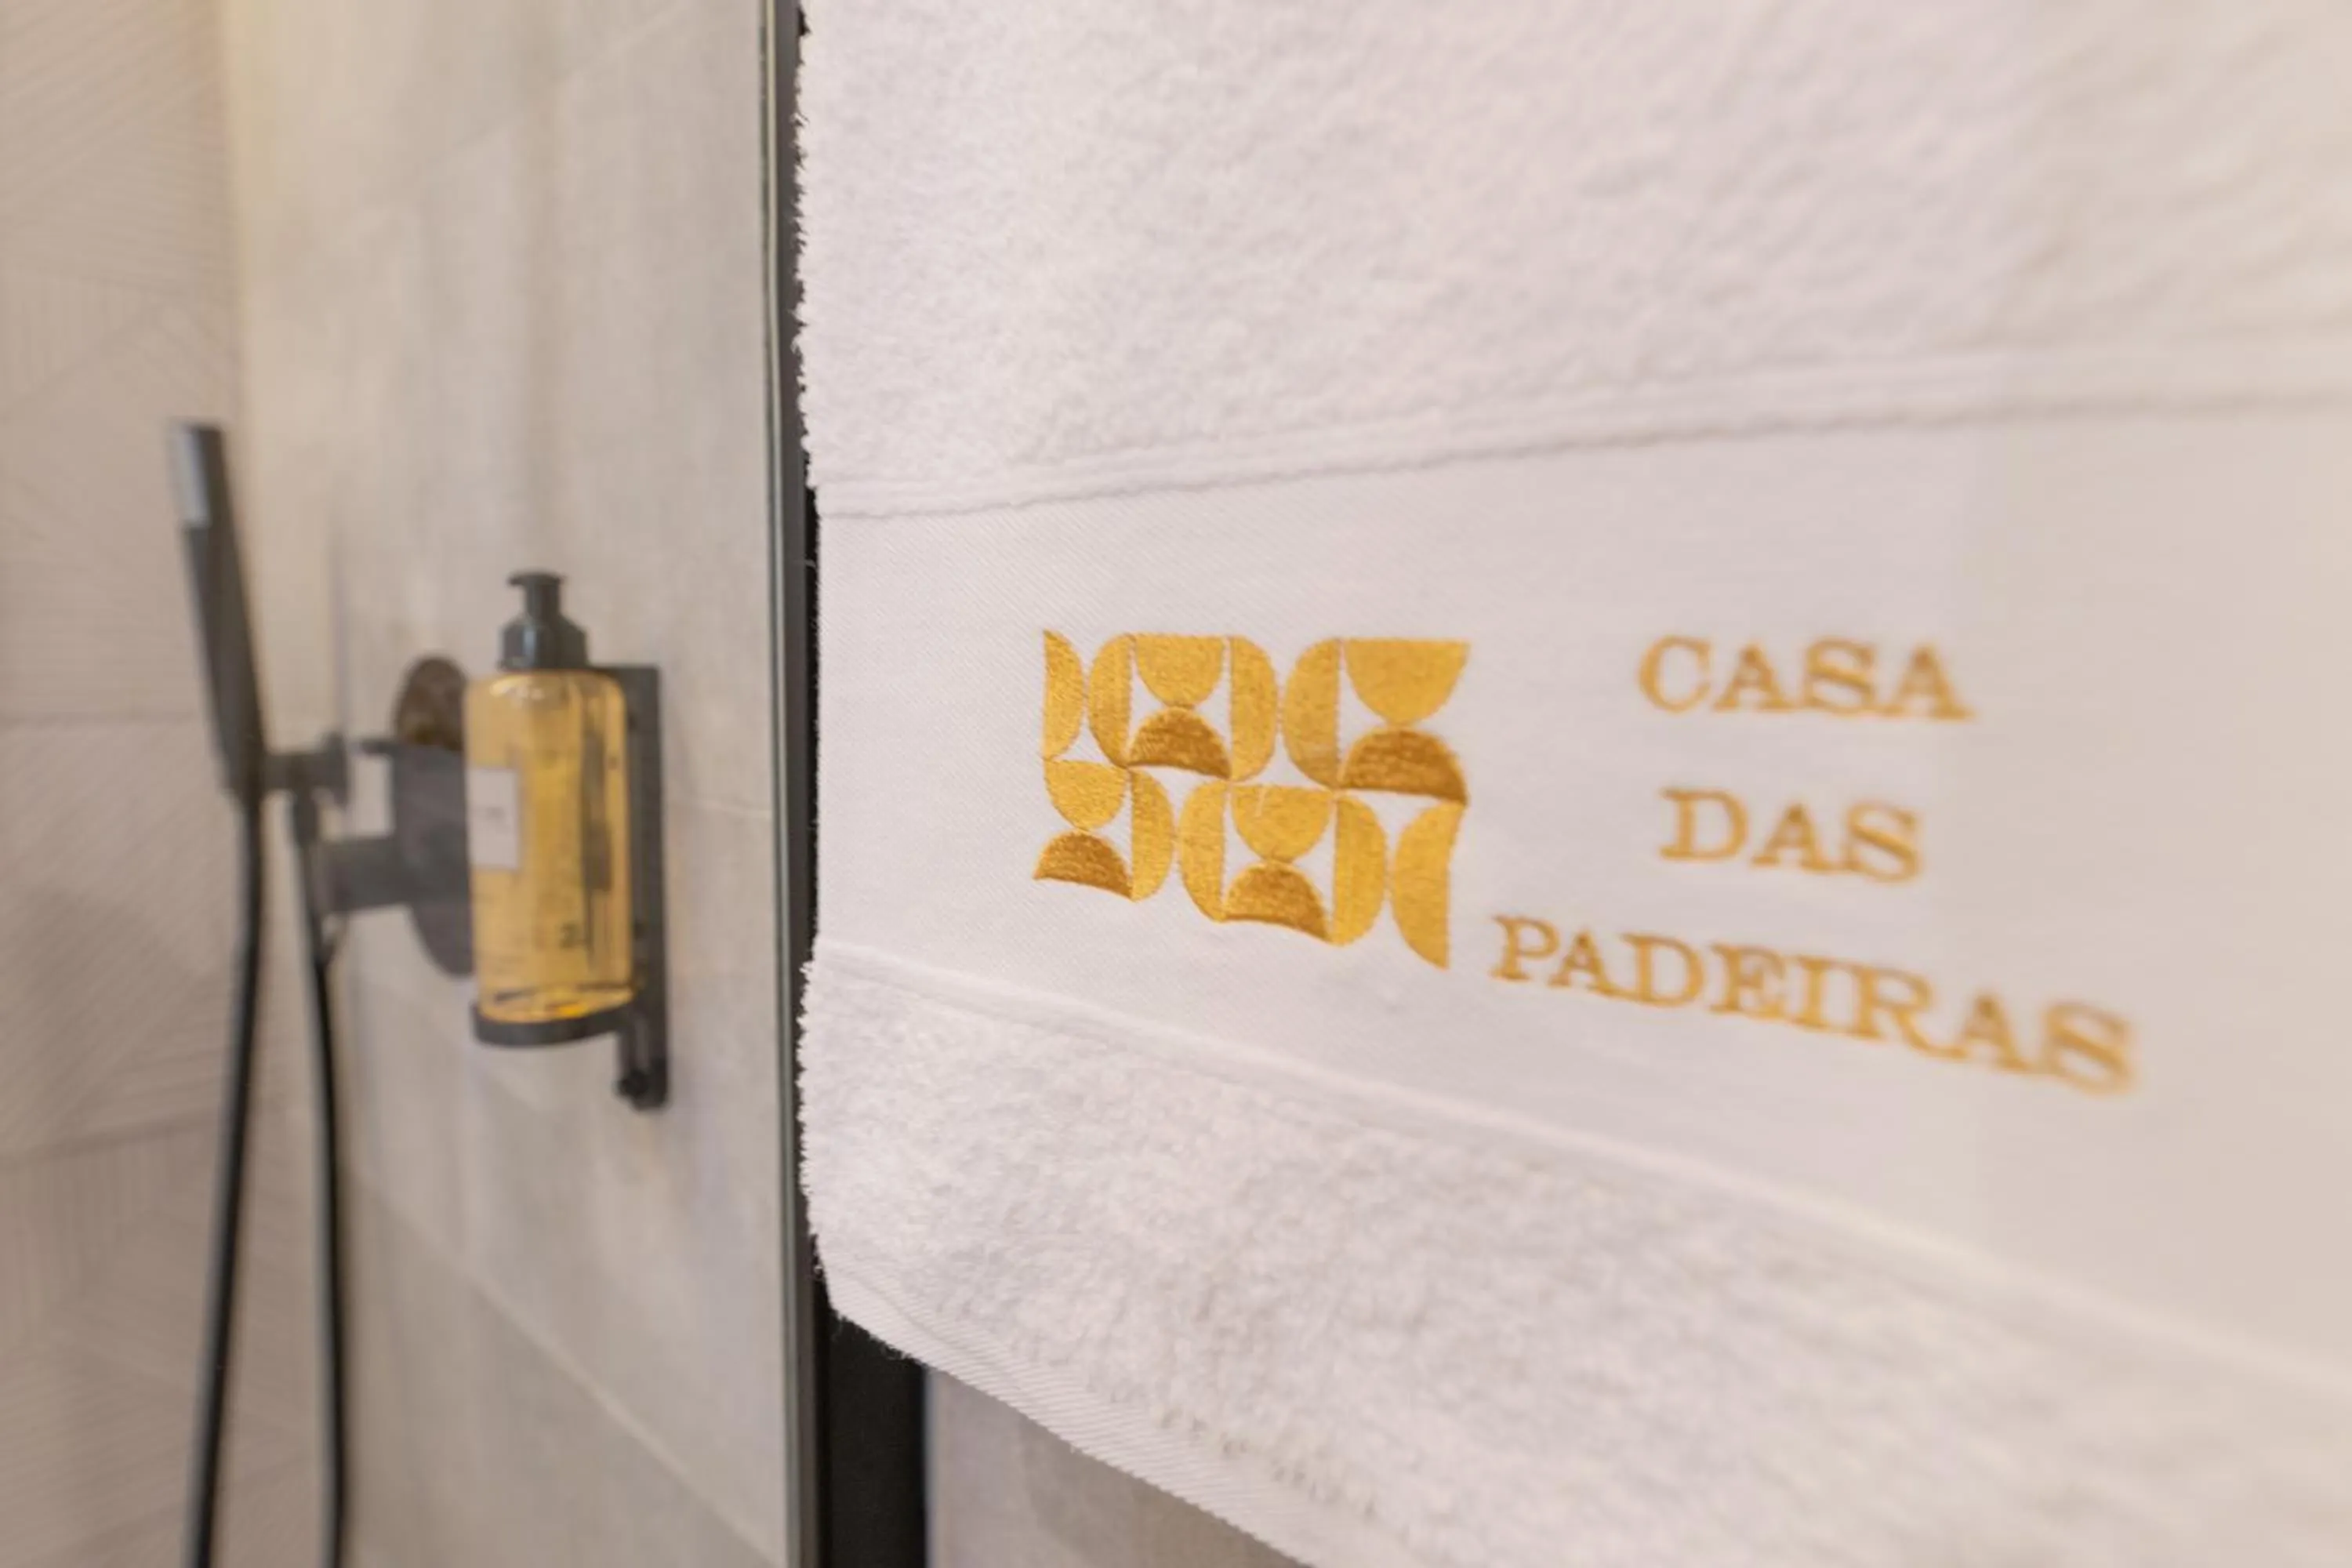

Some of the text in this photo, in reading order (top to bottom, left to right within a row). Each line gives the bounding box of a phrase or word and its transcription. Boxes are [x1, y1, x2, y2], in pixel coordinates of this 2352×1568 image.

[1638, 636, 1975, 722] CASA
[1660, 788, 1923, 883] DAS
[1490, 915, 2134, 1094] PADEIRAS
